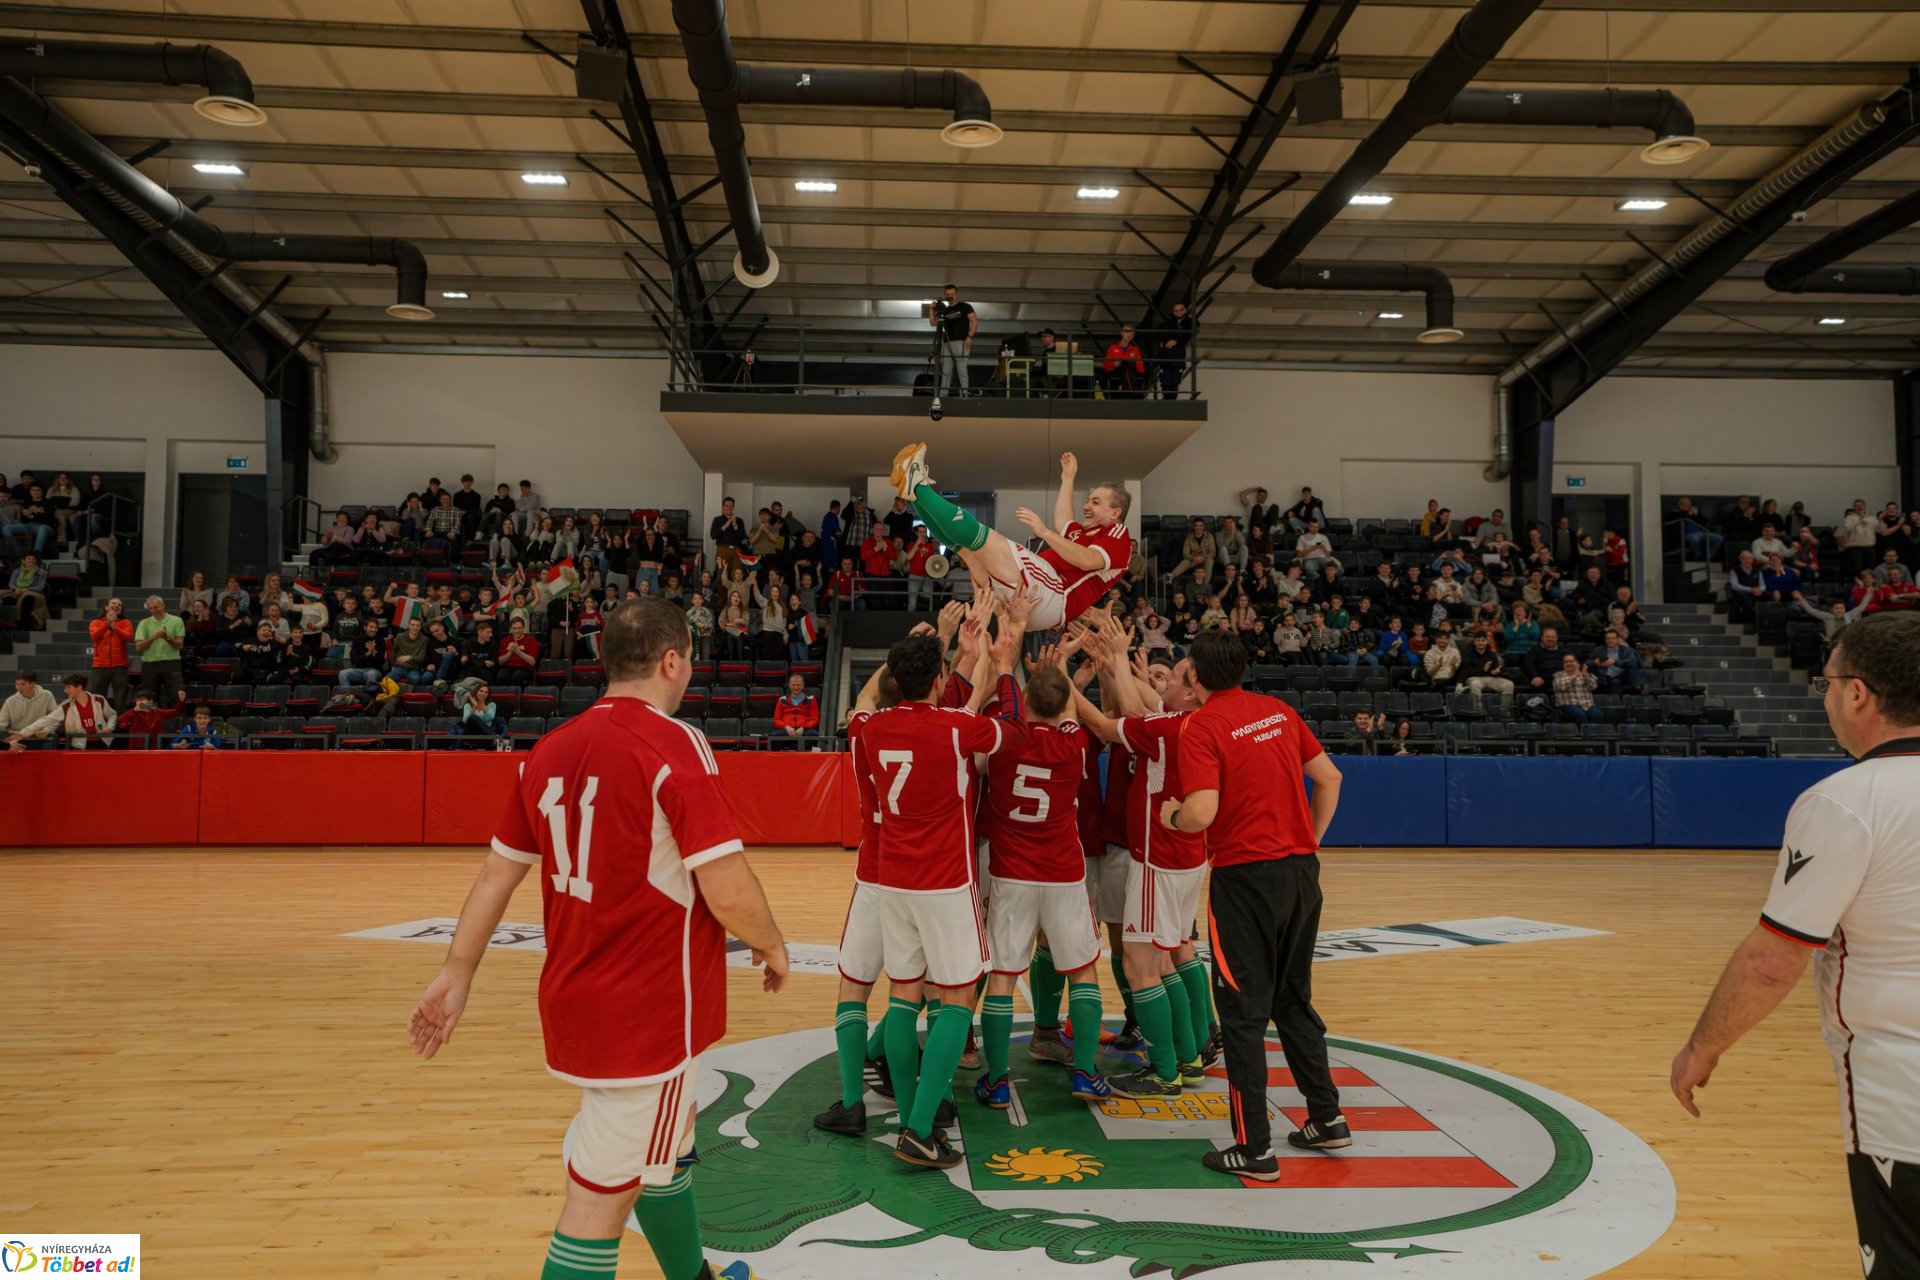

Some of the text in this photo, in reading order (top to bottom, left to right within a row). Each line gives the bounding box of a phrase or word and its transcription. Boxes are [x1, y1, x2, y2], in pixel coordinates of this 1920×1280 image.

[1231, 711, 1288, 740] MAGYARORSZÁG
[1252, 727, 1283, 744] HUNGARY
[878, 749, 914, 816] 7
[1008, 763, 1052, 823] 5
[537, 776, 599, 903] 11
